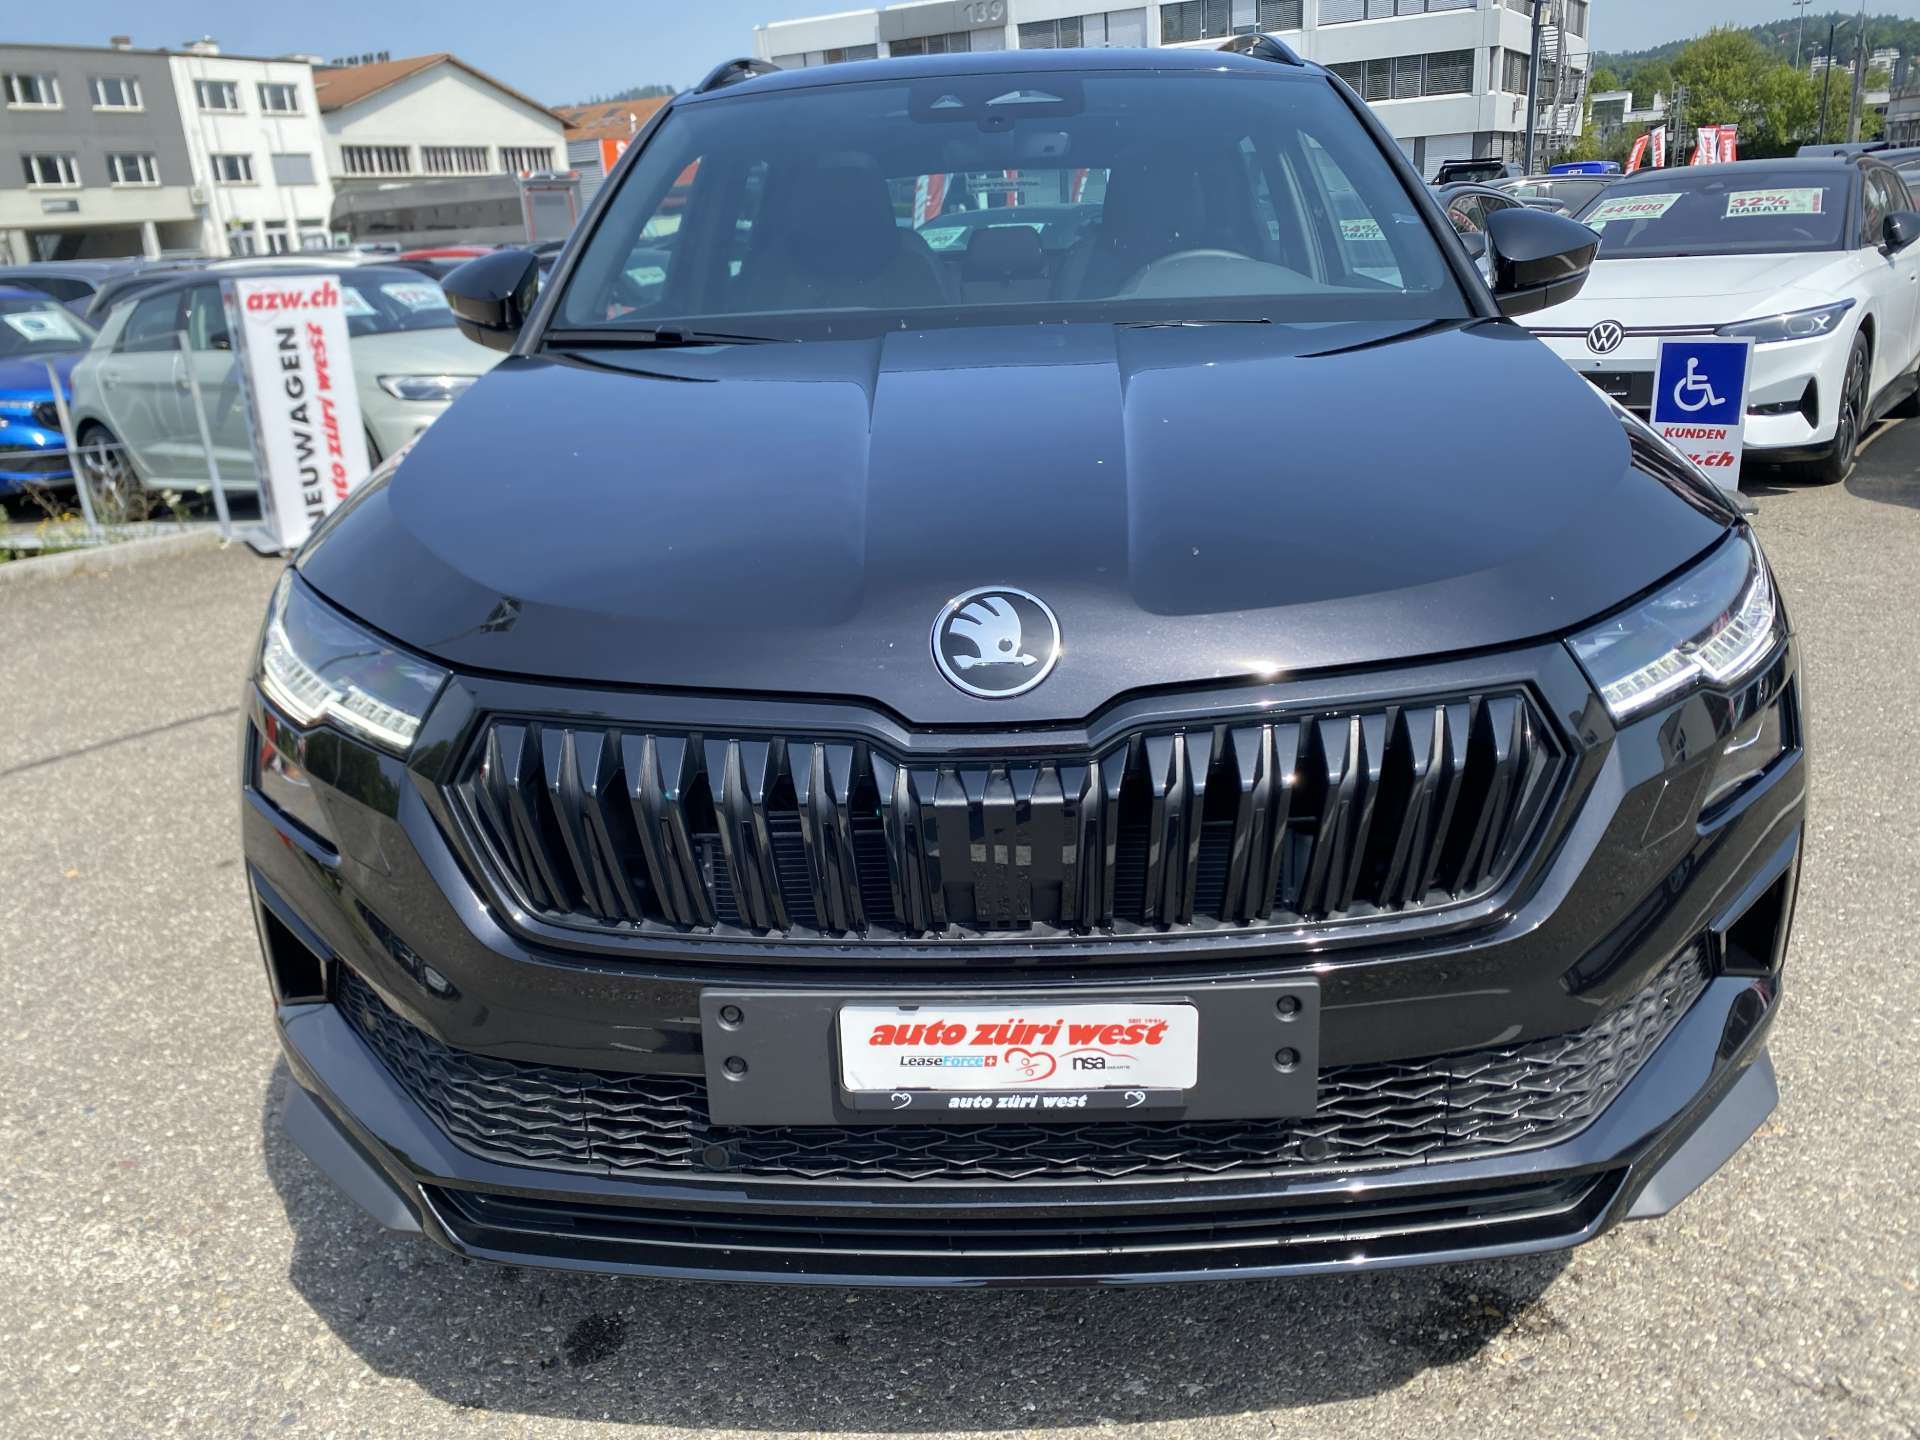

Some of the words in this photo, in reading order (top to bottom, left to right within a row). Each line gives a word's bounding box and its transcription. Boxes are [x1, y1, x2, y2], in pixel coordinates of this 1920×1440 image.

[964, 1, 1003, 23] 139
[246, 281, 339, 312] azw.ch
[305, 322, 332, 391] west
[1664, 427, 1727, 439] KUNDEN
[868, 1019, 967, 1046] auto
[969, 1018, 1064, 1046] züri
[1068, 1020, 1169, 1046] west
[899, 1056, 984, 1067] LeaseForce
[1072, 1057, 1106, 1070] nsa
[948, 1096, 993, 1108] auto
[996, 1095, 1039, 1108] züri
[1042, 1095, 1088, 1108] west
